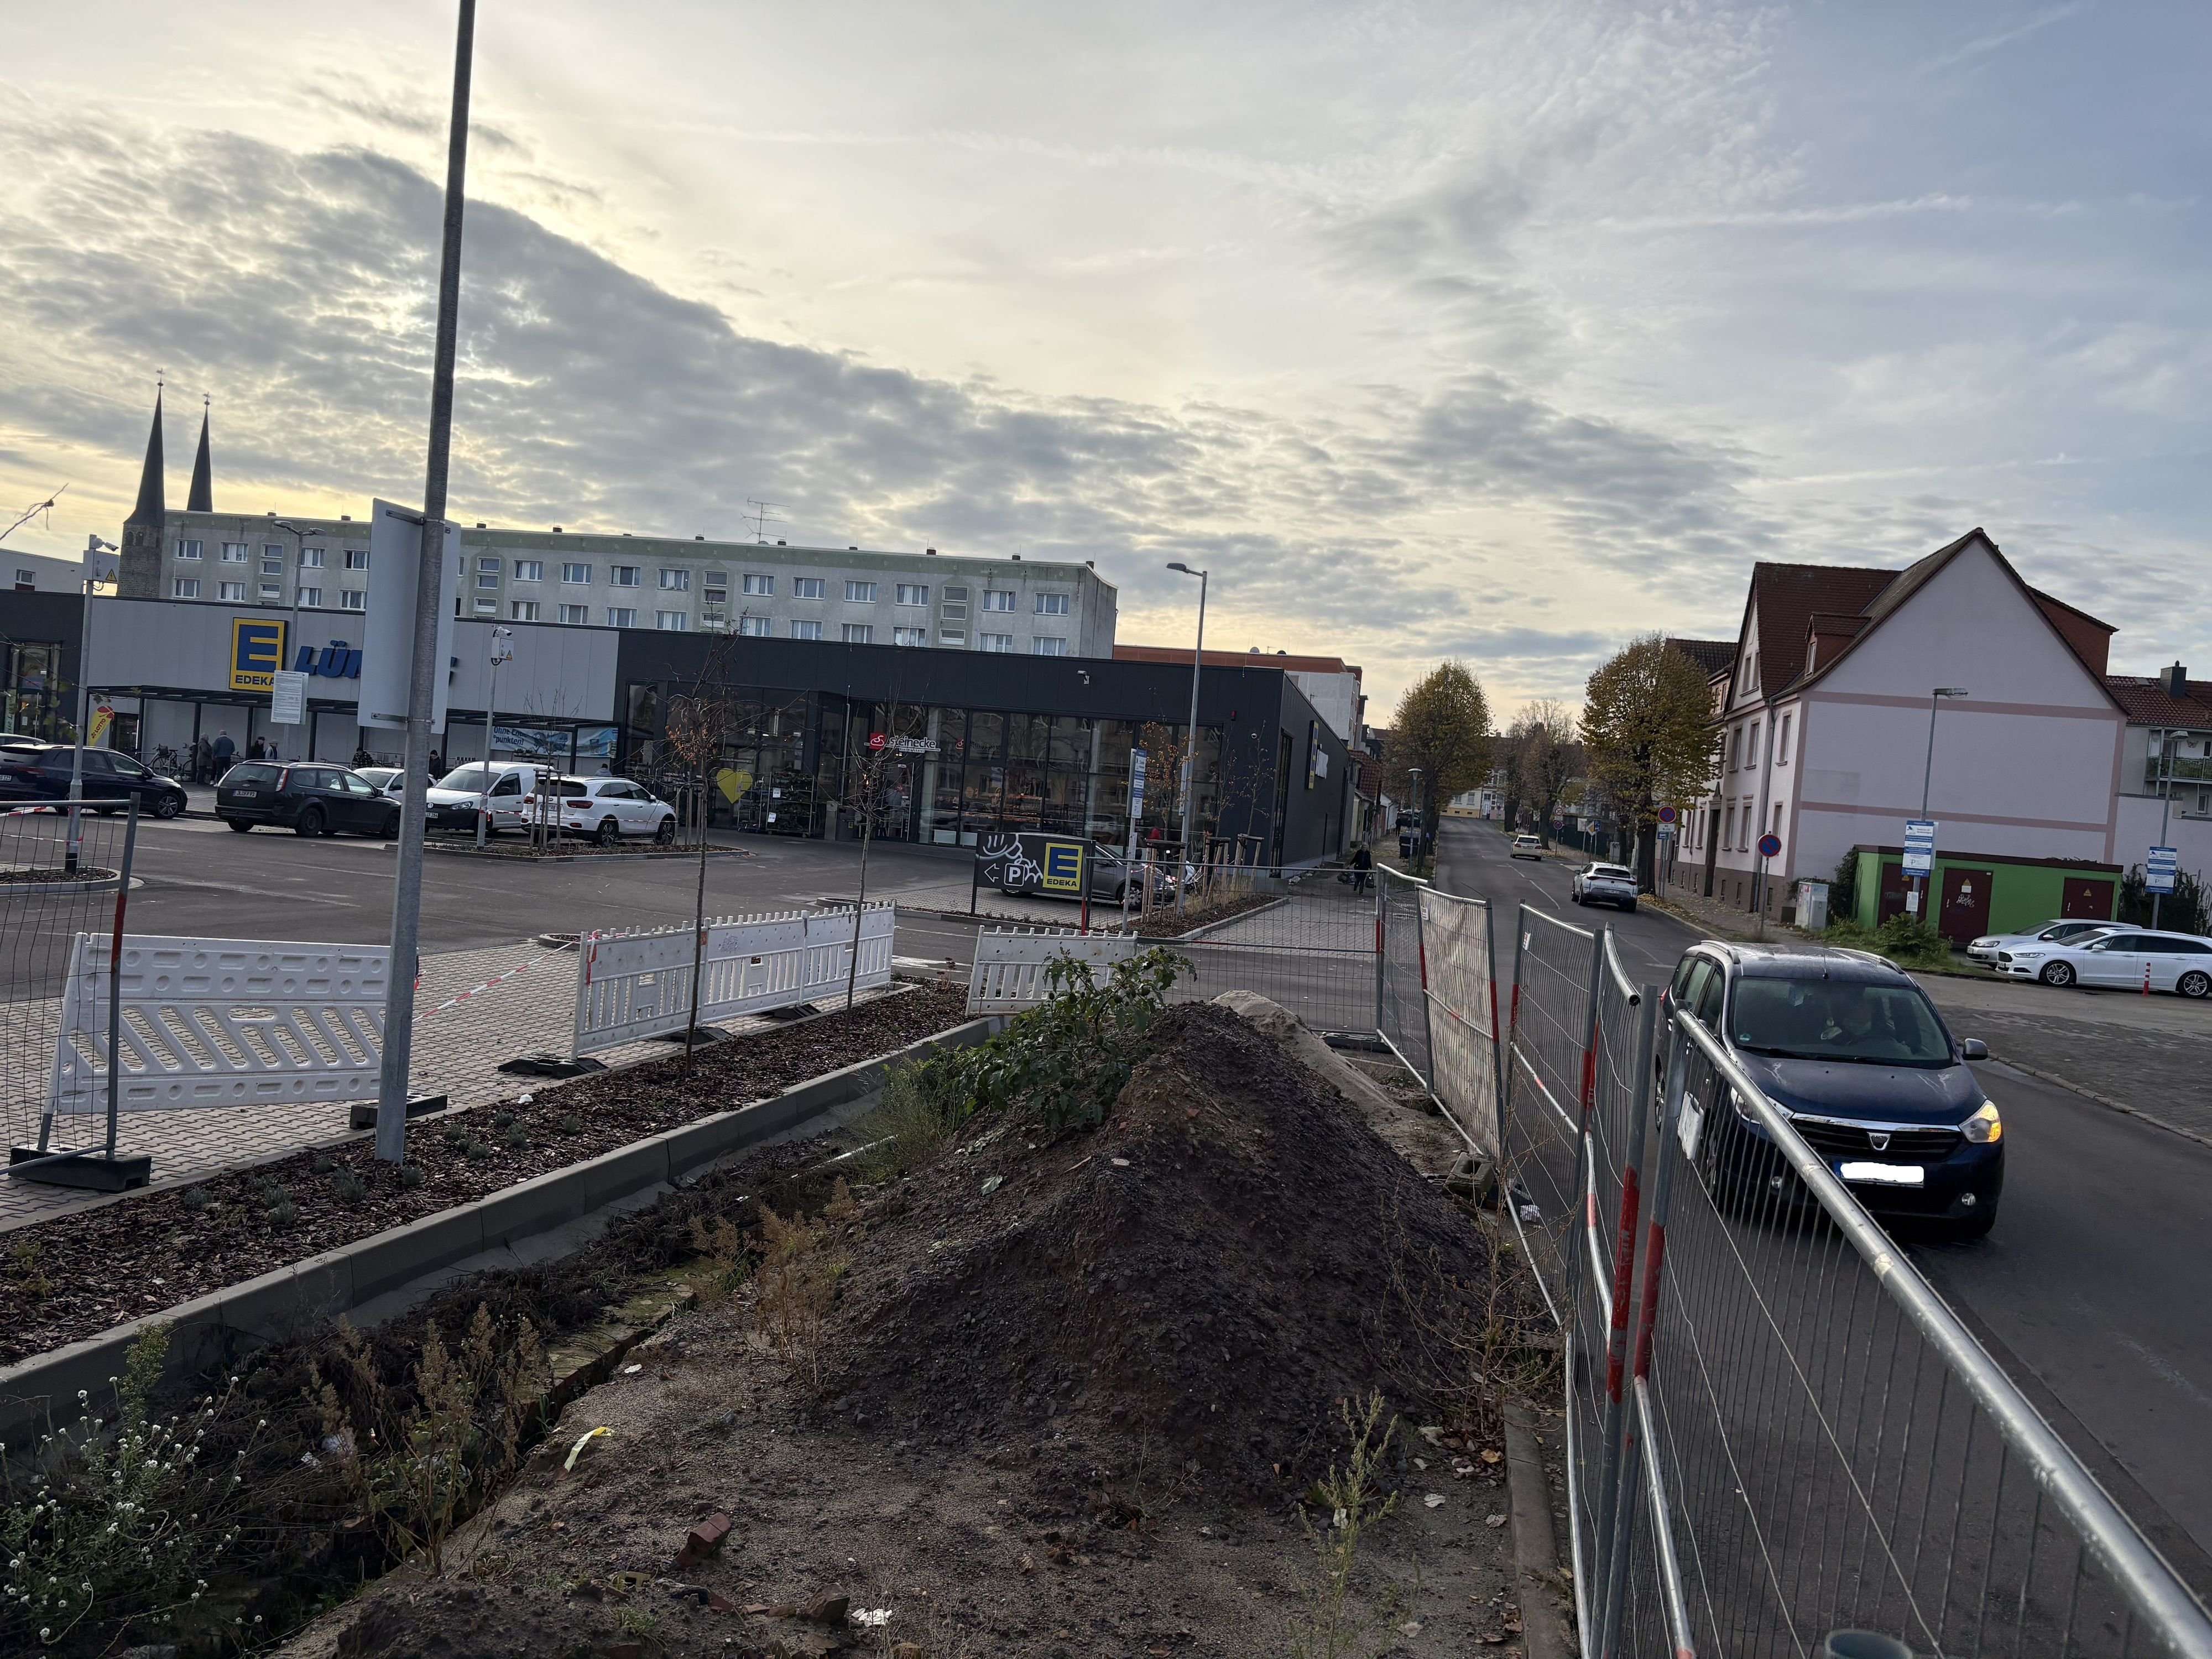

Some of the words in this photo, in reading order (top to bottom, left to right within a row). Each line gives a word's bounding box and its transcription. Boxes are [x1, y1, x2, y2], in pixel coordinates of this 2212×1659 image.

[95, 718, 106, 733] LOTTO
[889, 736, 936, 749] steinecke
[1008, 867, 1021, 883] P
[1046, 879, 1077, 887] EDEKA
